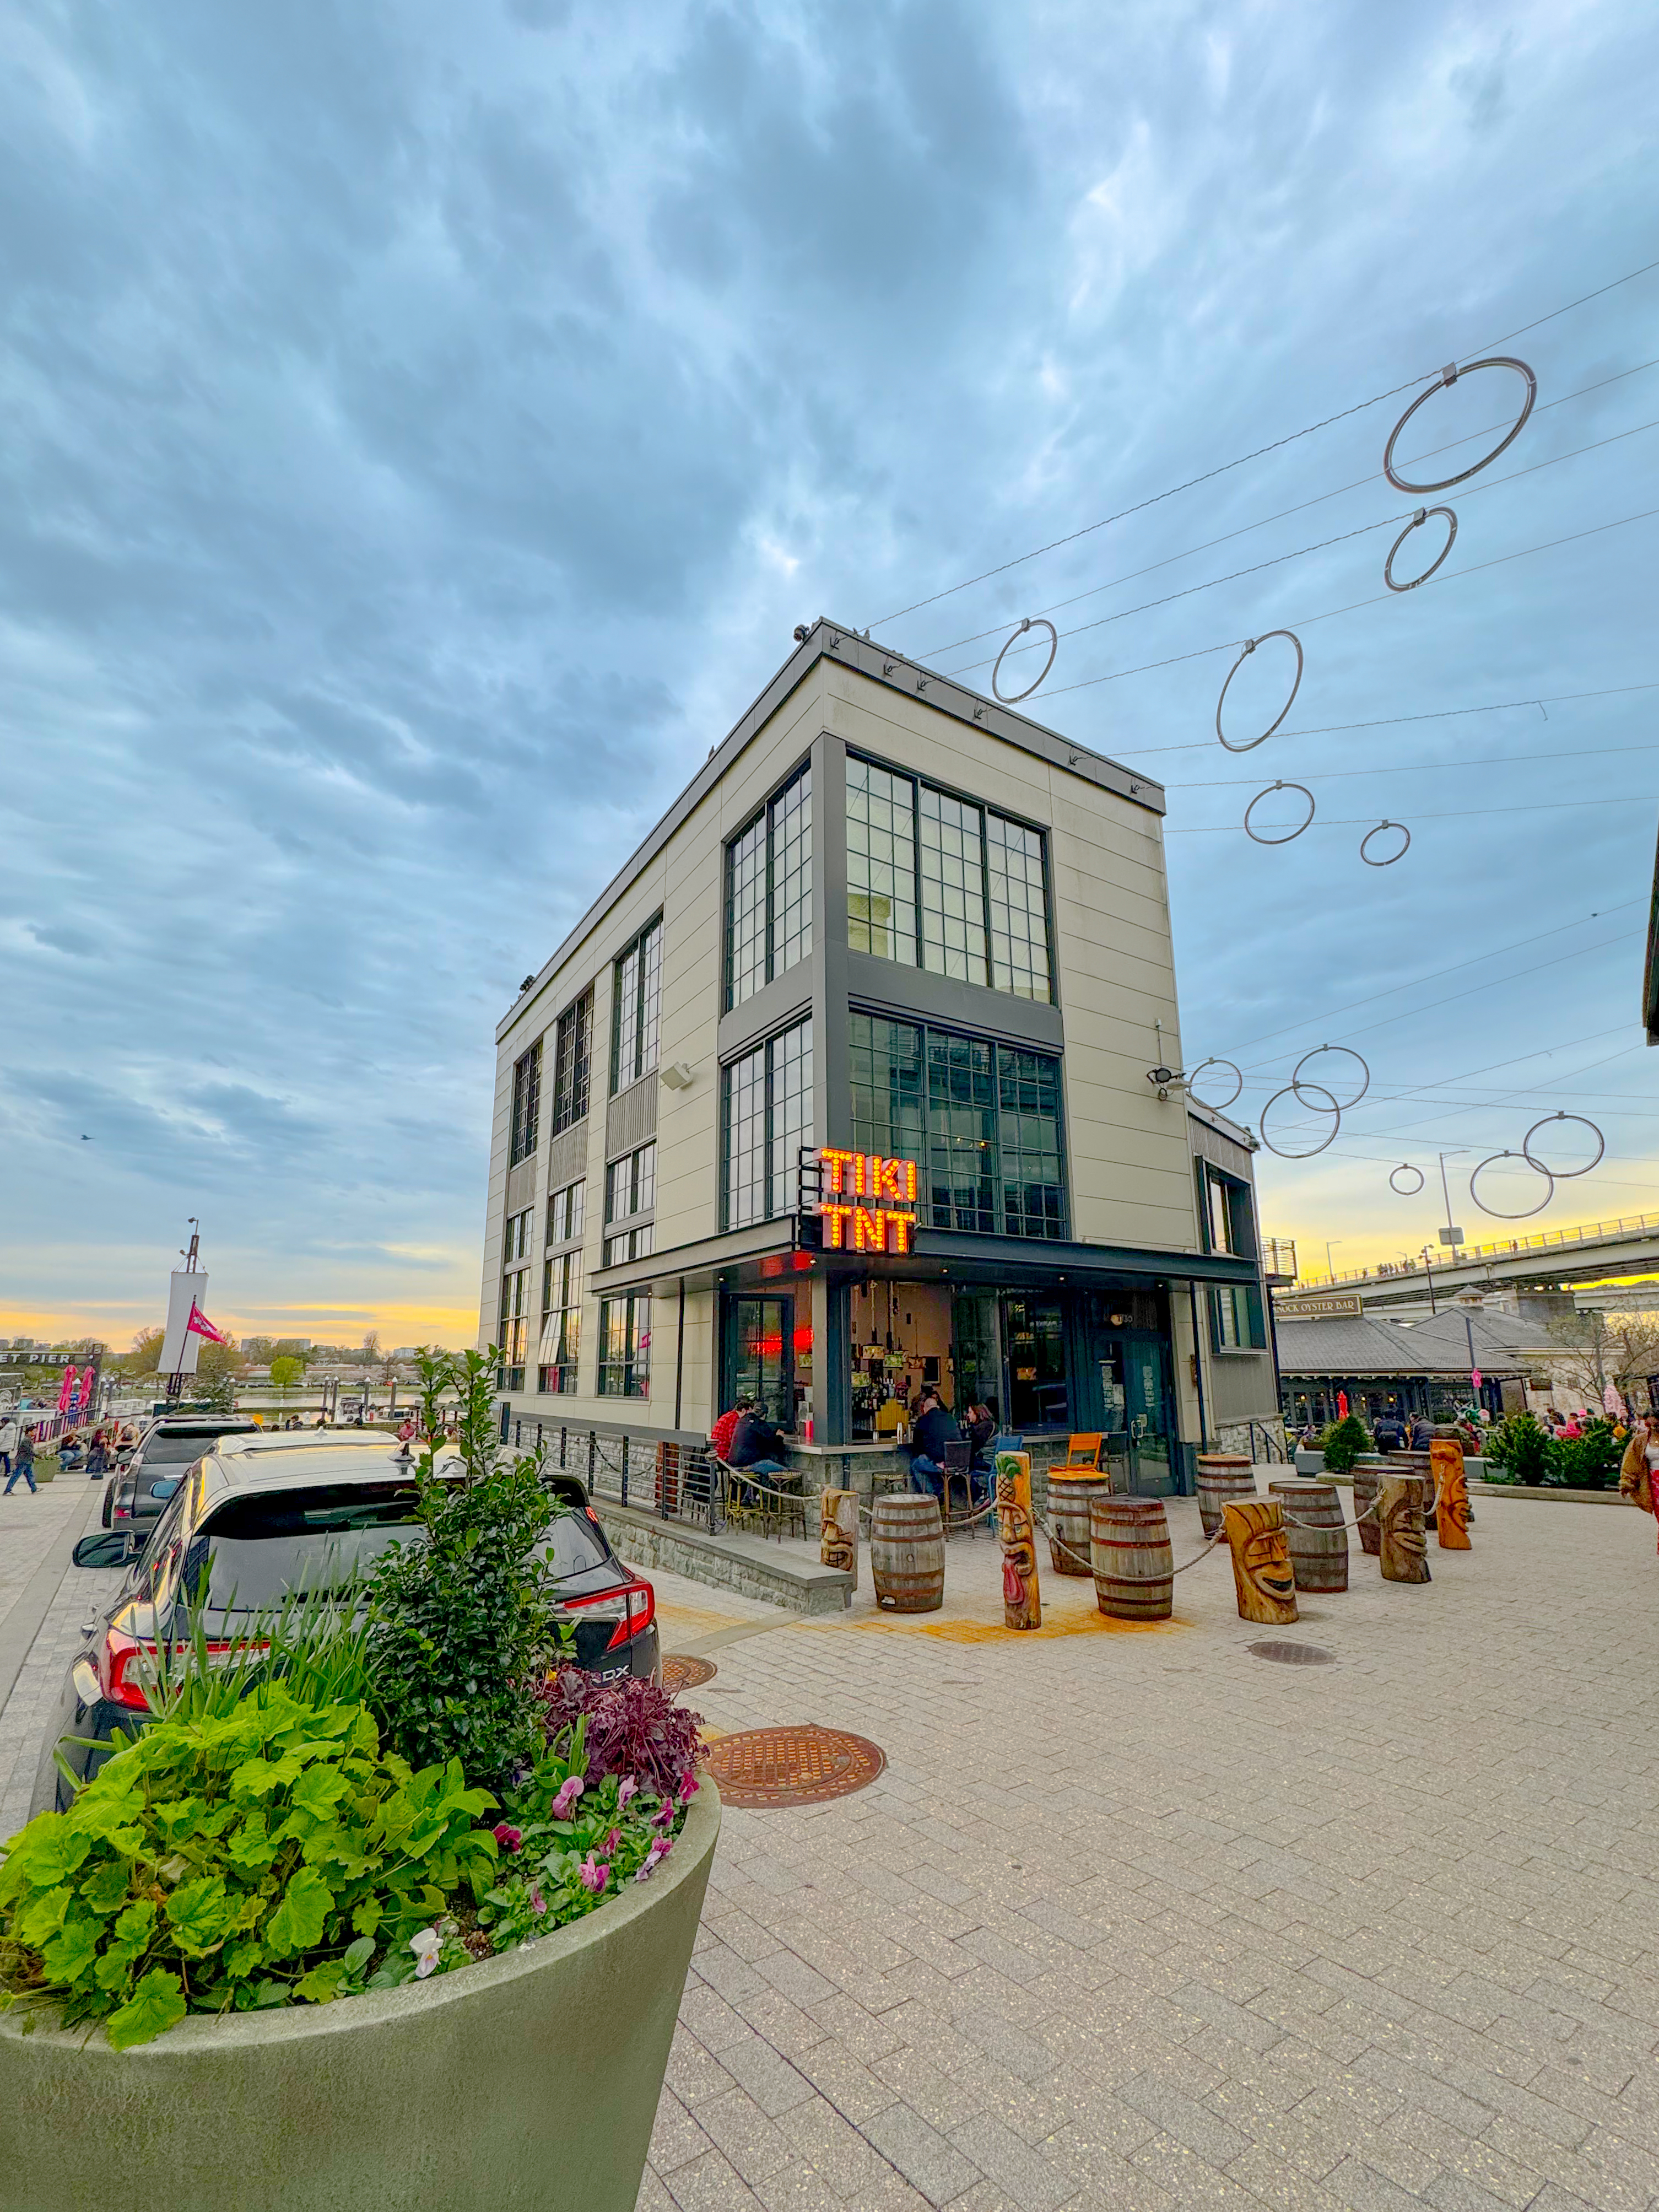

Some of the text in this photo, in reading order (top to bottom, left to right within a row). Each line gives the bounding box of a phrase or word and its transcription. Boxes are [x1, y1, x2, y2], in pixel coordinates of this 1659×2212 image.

[814, 1148, 916, 1202] TIKI
[813, 1203, 916, 1253] TNT
[1301, 1302, 1334, 1312] OYSTER
[1336, 1301, 1355, 1310] BAR
[0, 1354, 69, 1363] ET PIER
[592, 1664, 629, 1684] DX
